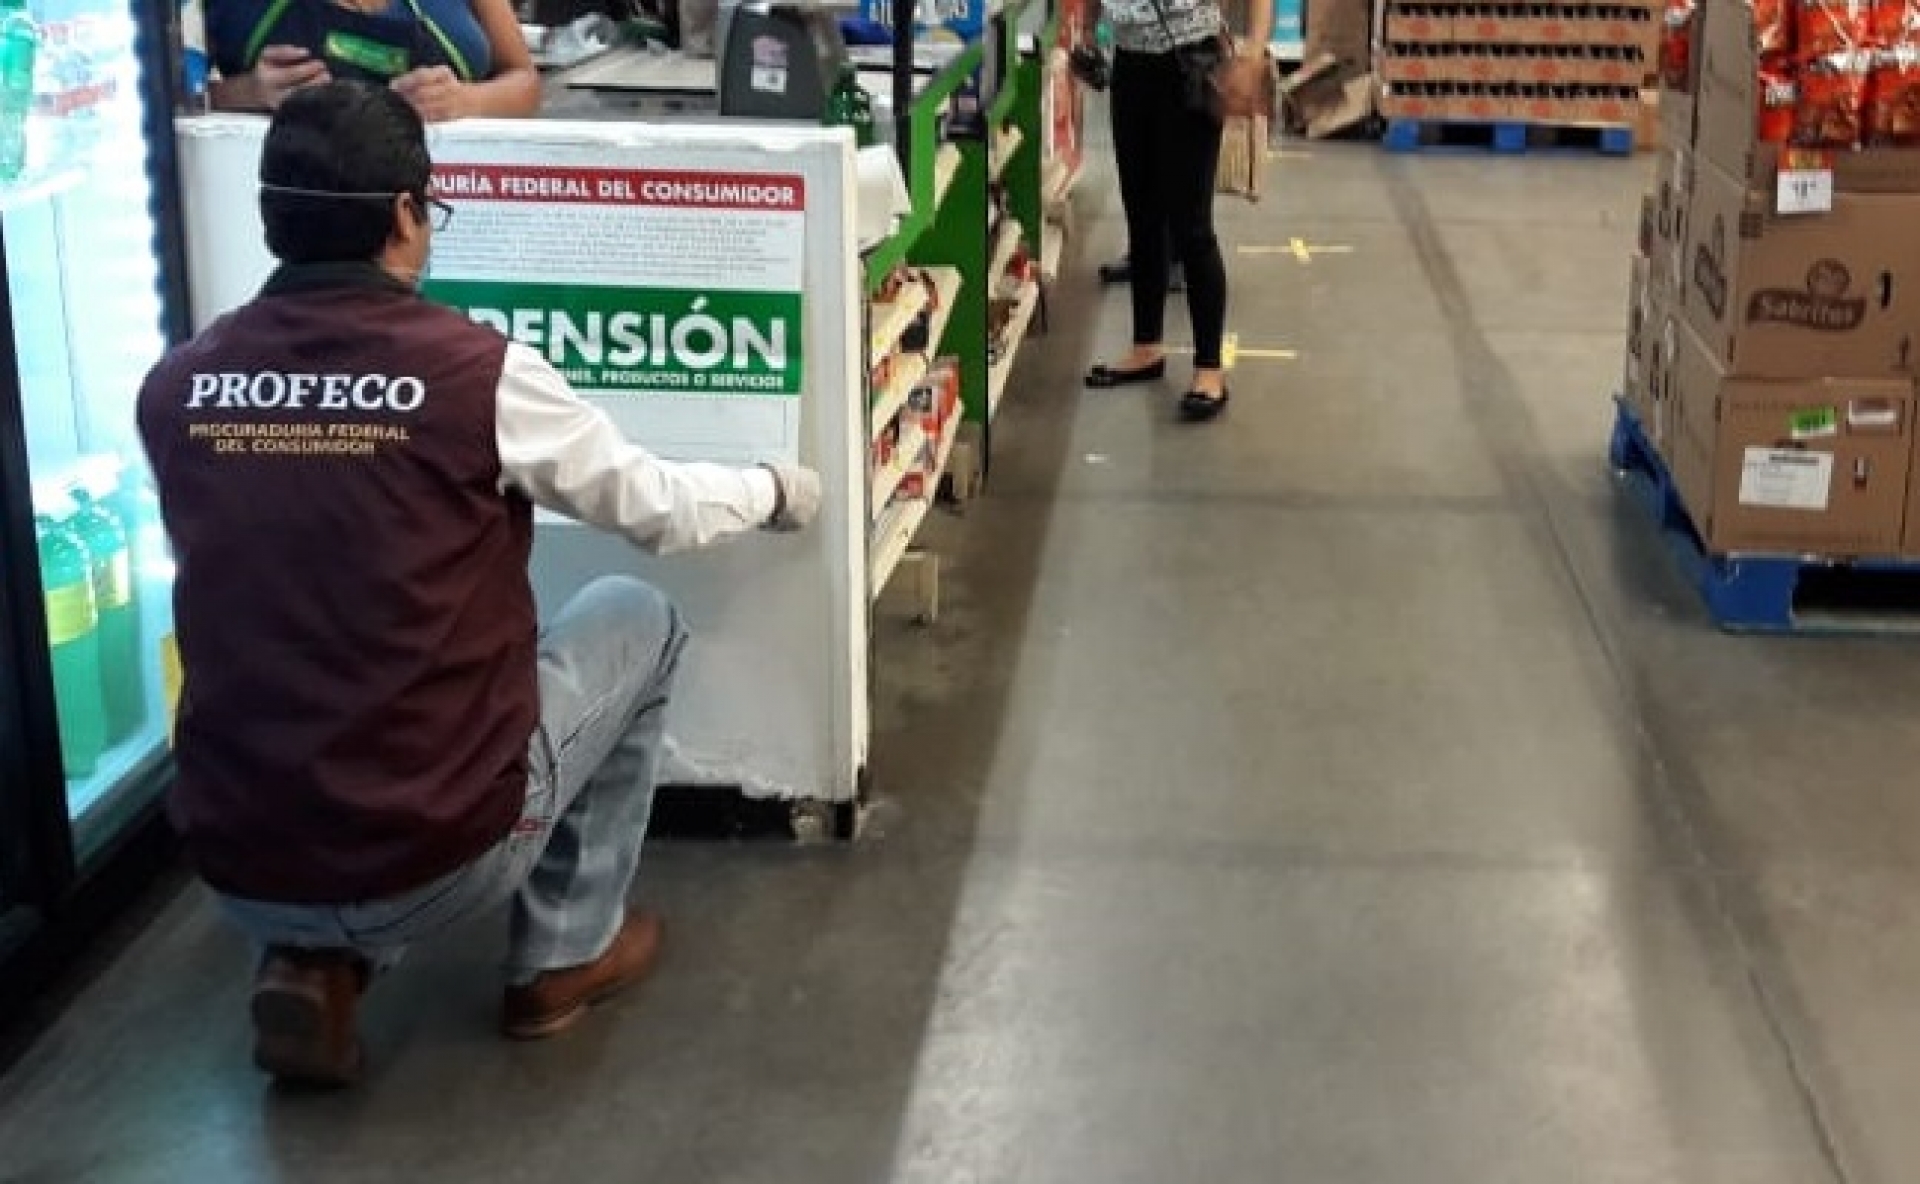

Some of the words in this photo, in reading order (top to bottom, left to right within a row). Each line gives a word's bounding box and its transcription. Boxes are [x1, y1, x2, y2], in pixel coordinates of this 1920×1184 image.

[501, 177, 591, 198] FEDERAL
[599, 180, 635, 200] DEL
[642, 181, 793, 205] CONSUMIDOR
[601, 370, 688, 386] PRODUCTOS
[186, 371, 425, 411] PROFECO
[328, 423, 410, 440] FEDERAL
[215, 439, 247, 453] DEL
[252, 440, 375, 454] CONSUMIDOR
